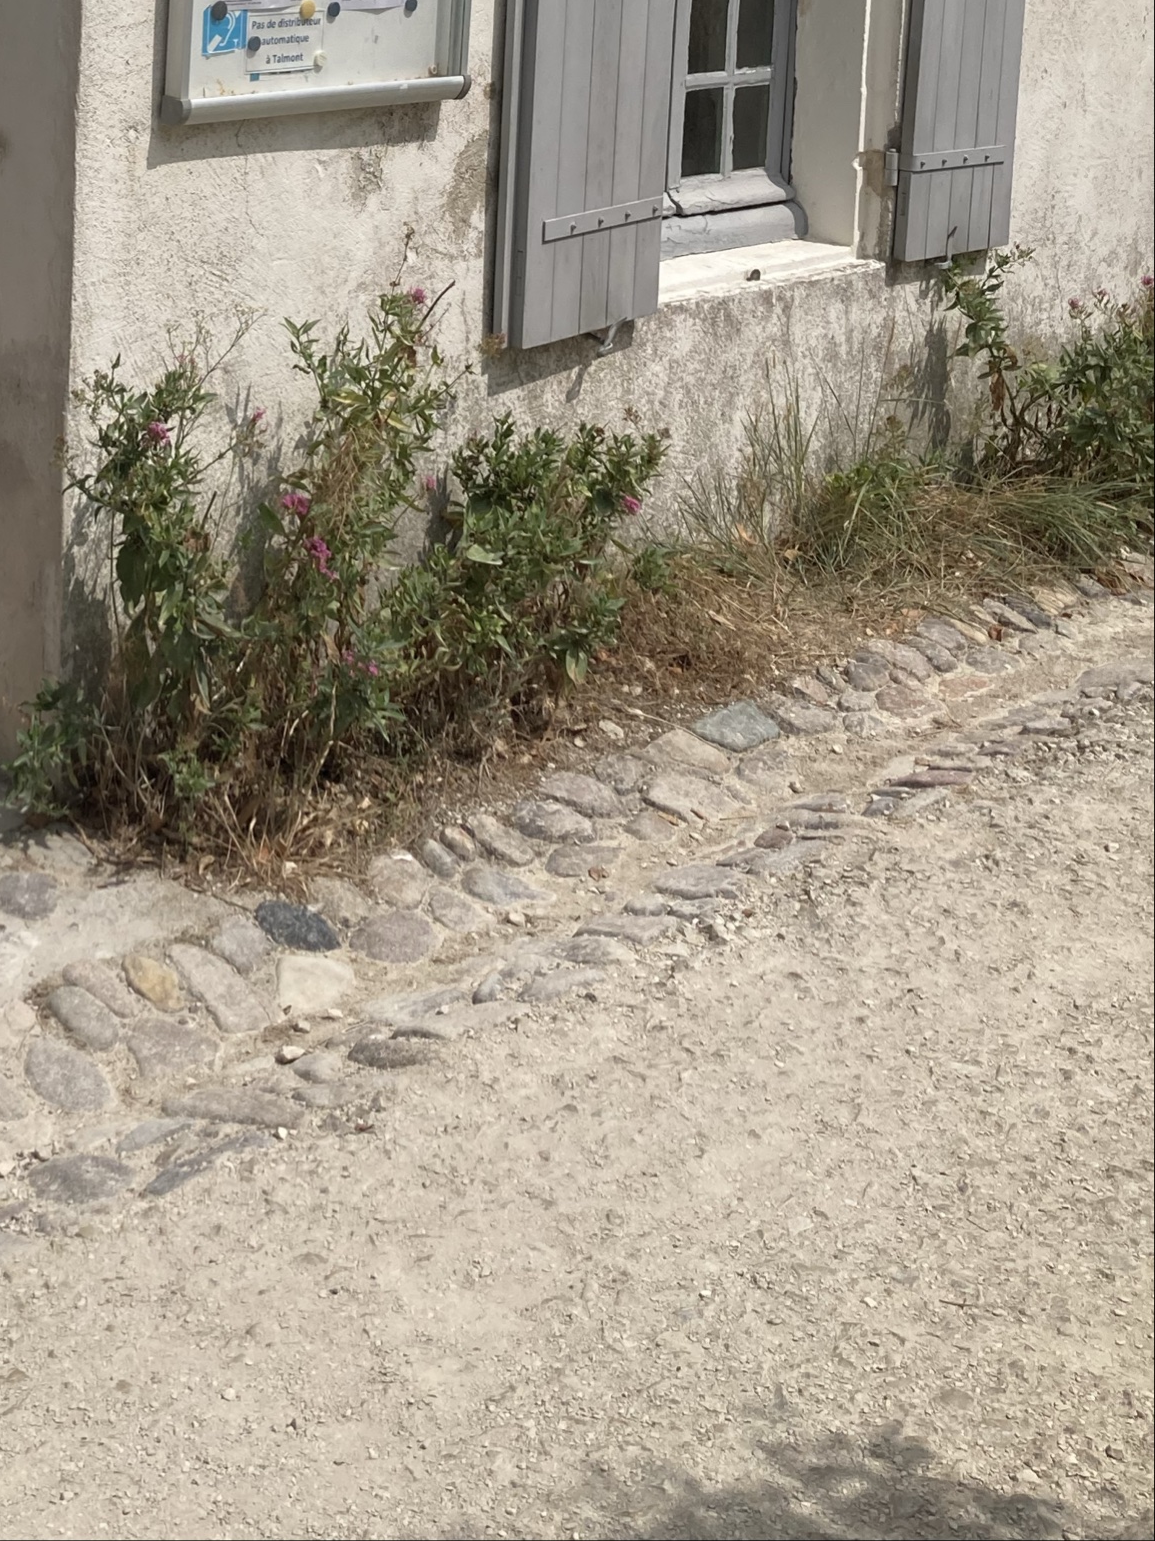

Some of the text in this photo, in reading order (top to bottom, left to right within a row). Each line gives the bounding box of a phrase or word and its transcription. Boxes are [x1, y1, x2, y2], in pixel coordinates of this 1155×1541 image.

[252, 17, 321, 29] Pas de distributeur
[262, 34, 309, 46] automatique
[266, 52, 304, 64] à Talmont
